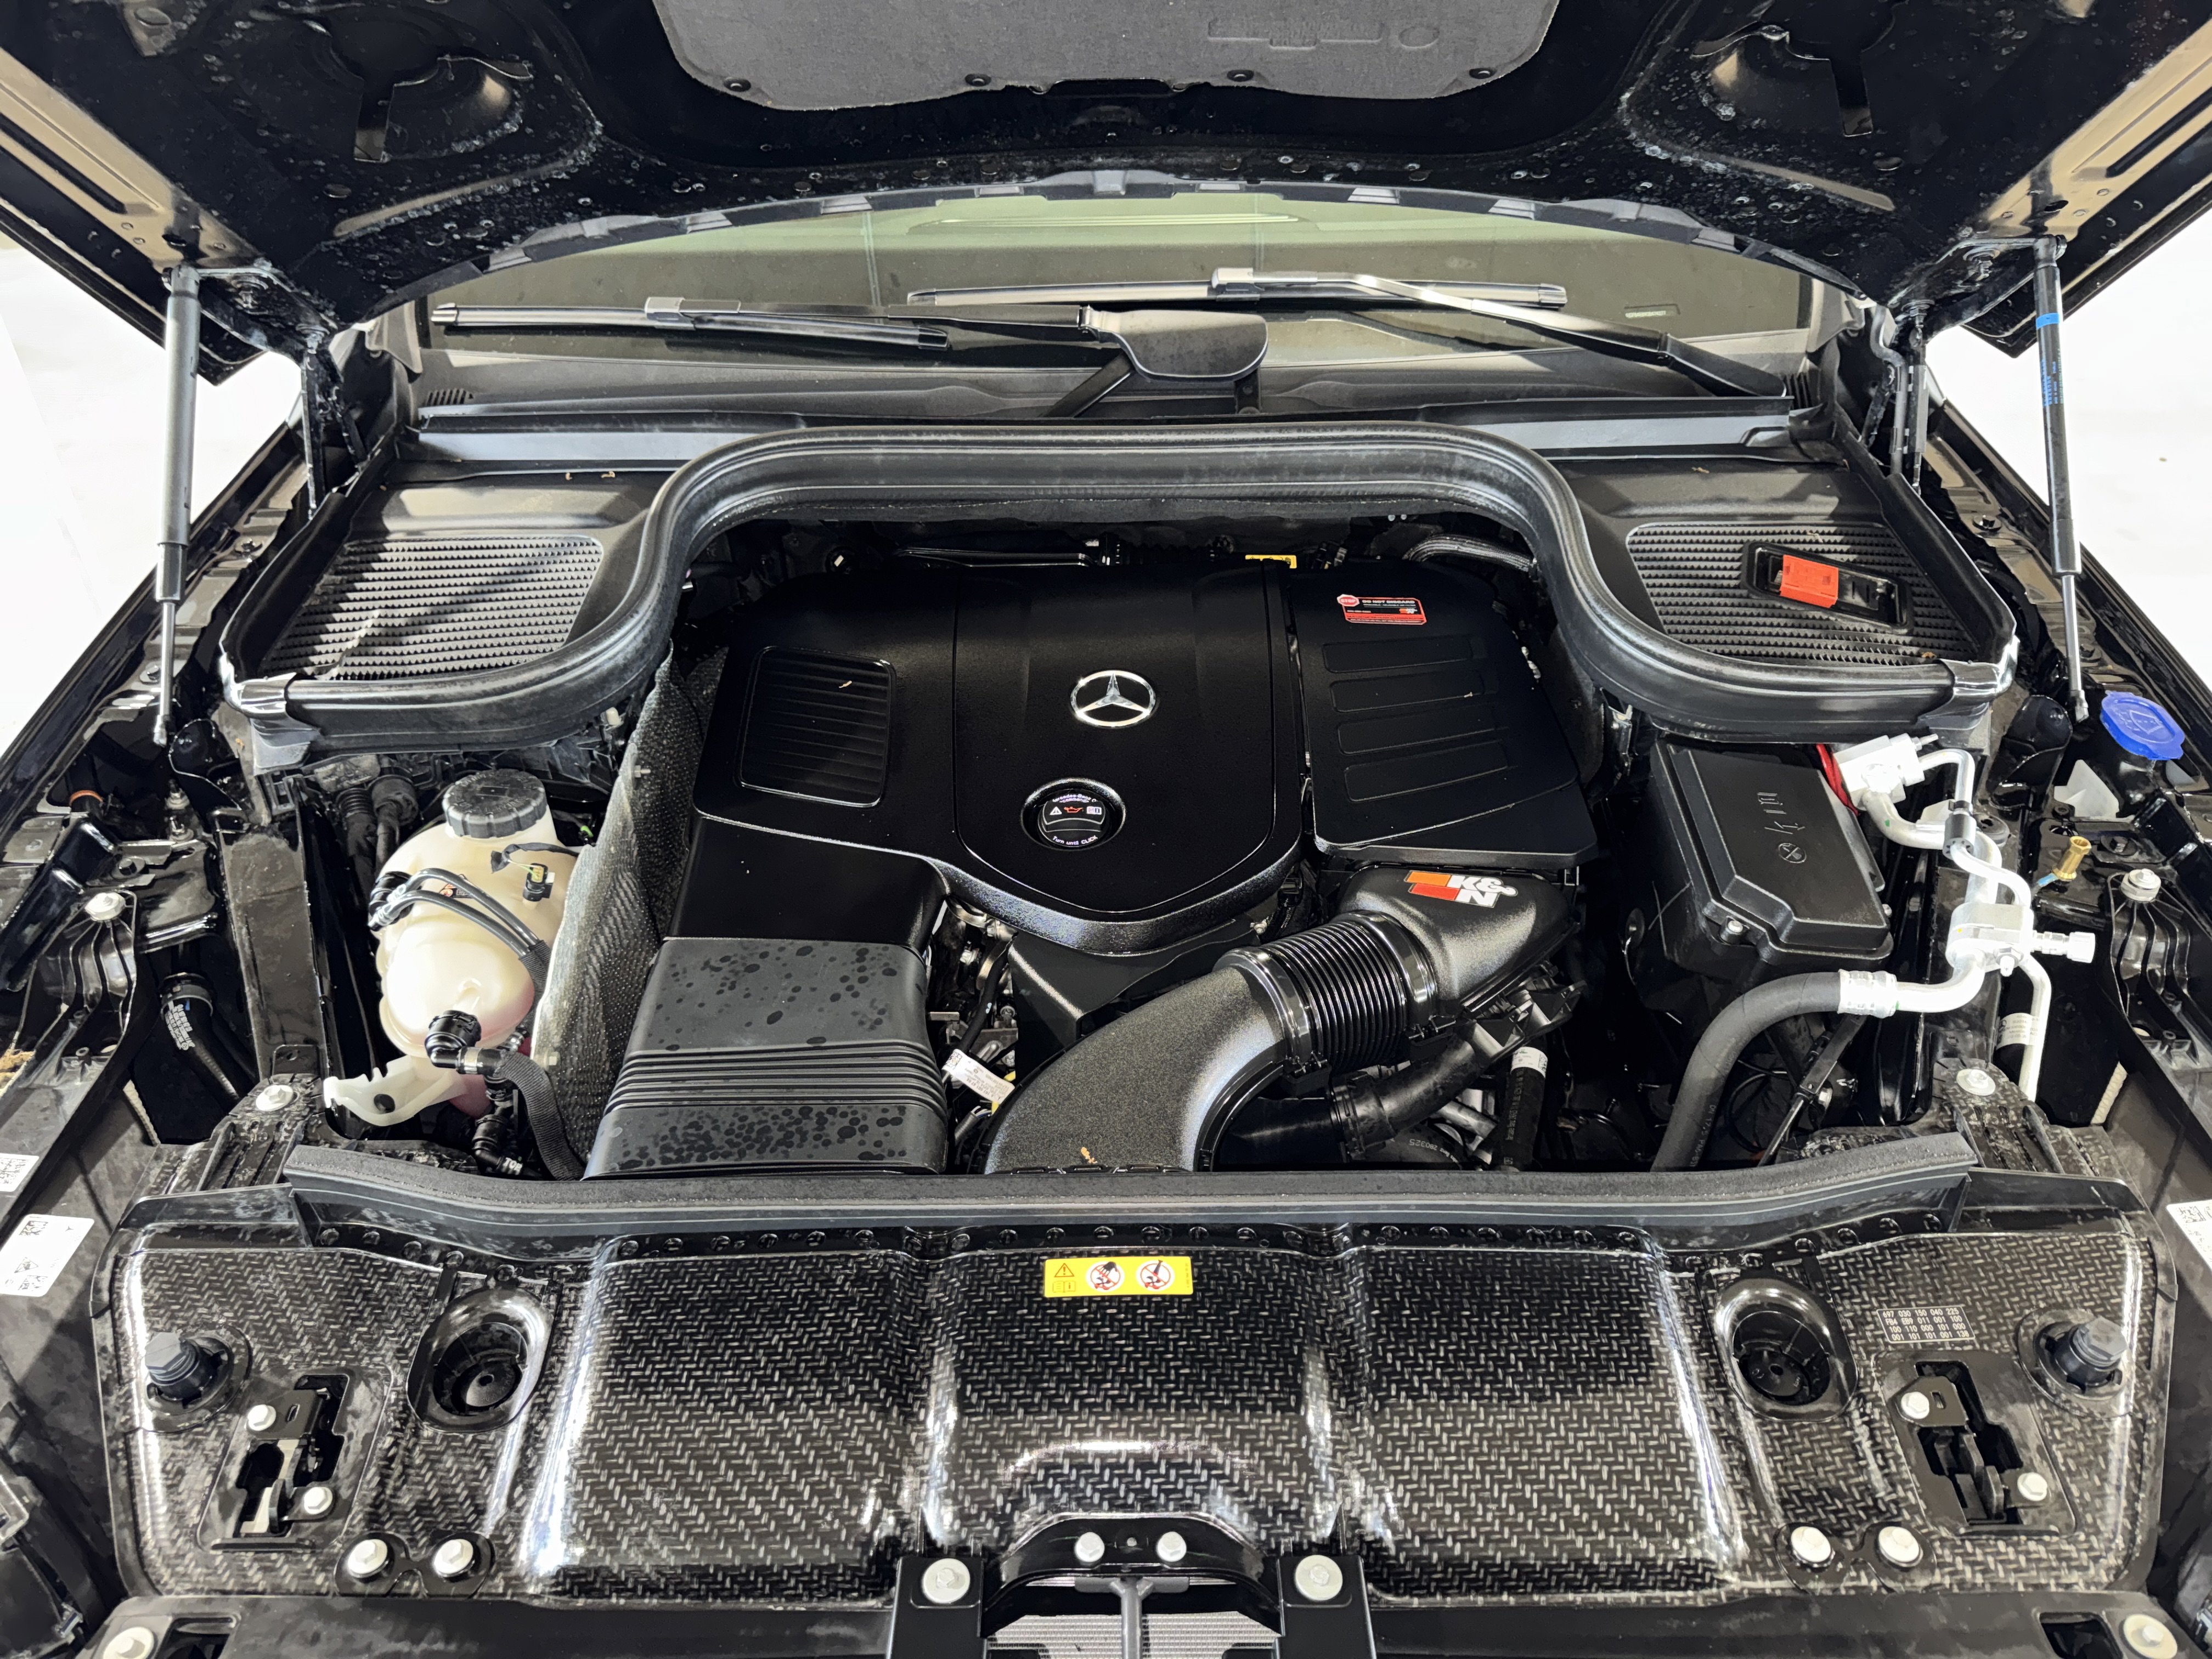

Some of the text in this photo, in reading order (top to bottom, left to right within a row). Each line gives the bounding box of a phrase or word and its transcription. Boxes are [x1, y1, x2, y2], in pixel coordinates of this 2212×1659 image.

[1081, 835, 1098, 844] CLICK
[1447, 875, 1518, 906] K&N
[1409, 1138, 1438, 1150] 280325
